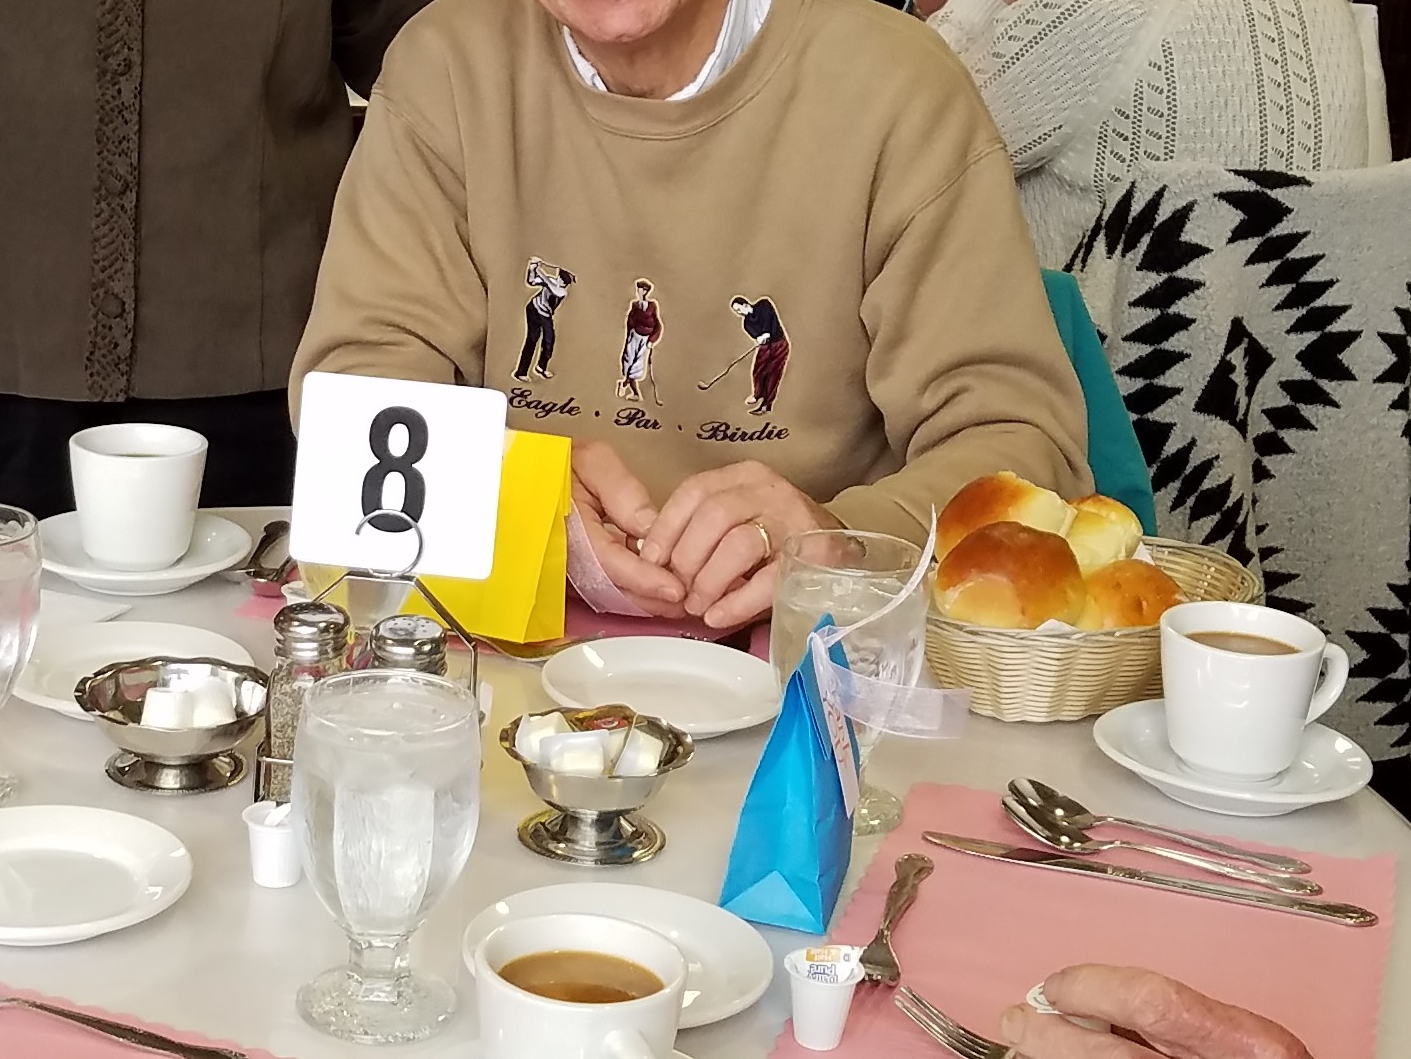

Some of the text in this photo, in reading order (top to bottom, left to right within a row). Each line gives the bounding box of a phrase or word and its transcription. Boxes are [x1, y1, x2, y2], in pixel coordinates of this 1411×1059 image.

[508, 387, 790, 443] Eagle Par Birdie
[361, 405, 429, 533] 8
[809, 964, 837, 976] Pure
